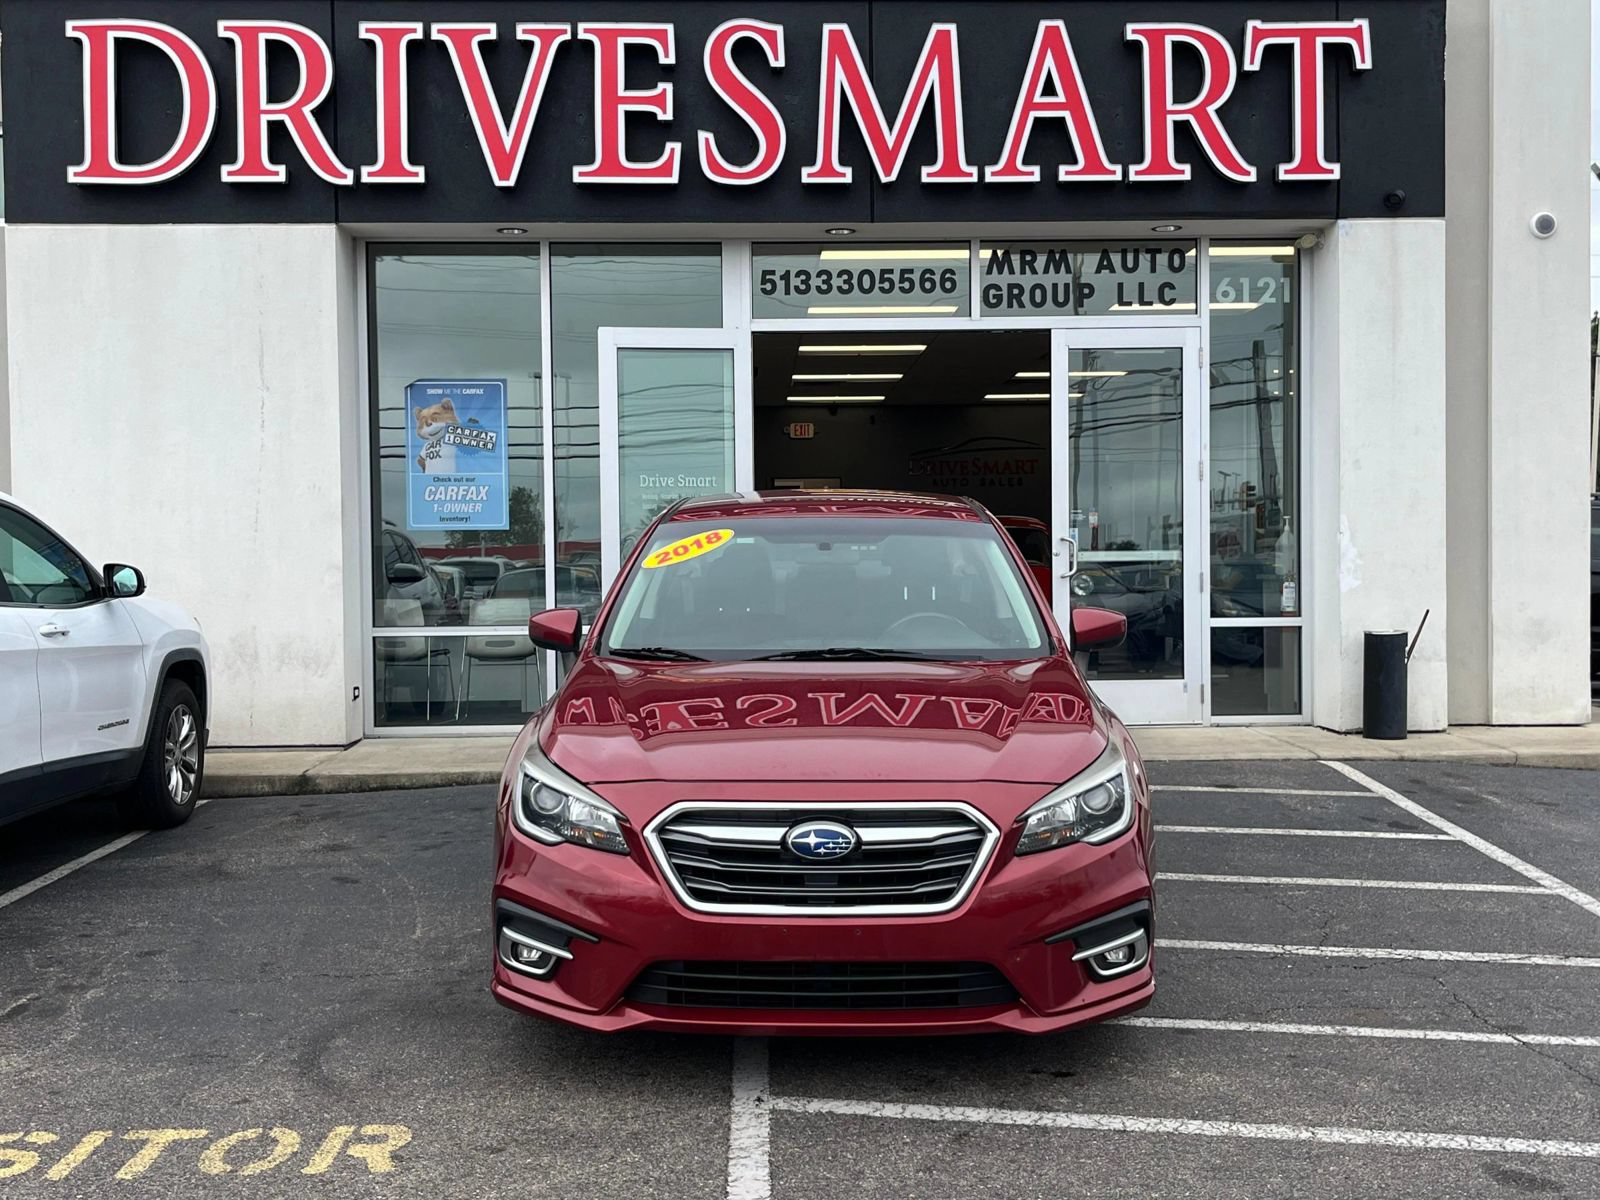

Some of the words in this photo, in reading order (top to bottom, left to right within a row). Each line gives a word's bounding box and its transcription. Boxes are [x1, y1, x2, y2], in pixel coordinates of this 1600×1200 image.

[65, 18, 1373, 188] DRIVESMART
[985, 248, 1073, 275] MRM
[1094, 247, 1186, 274] AUTO
[760, 268, 957, 296] 5133305566
[1215, 276, 1291, 304] 6121
[982, 282, 1095, 309] GROUP
[1116, 281, 1177, 307] LLC
[447, 425, 497, 441] CARFAX
[794, 423, 810, 437] EXIT
[425, 449, 442, 460] FOX
[639, 473, 675, 487] Drive
[677, 474, 718, 487] Smart
[424, 485, 489, 501] CARFAX
[432, 503, 482, 513] 1-OWNER
[439, 515, 471, 523] Inventory!
[654, 531, 723, 565] 2018
